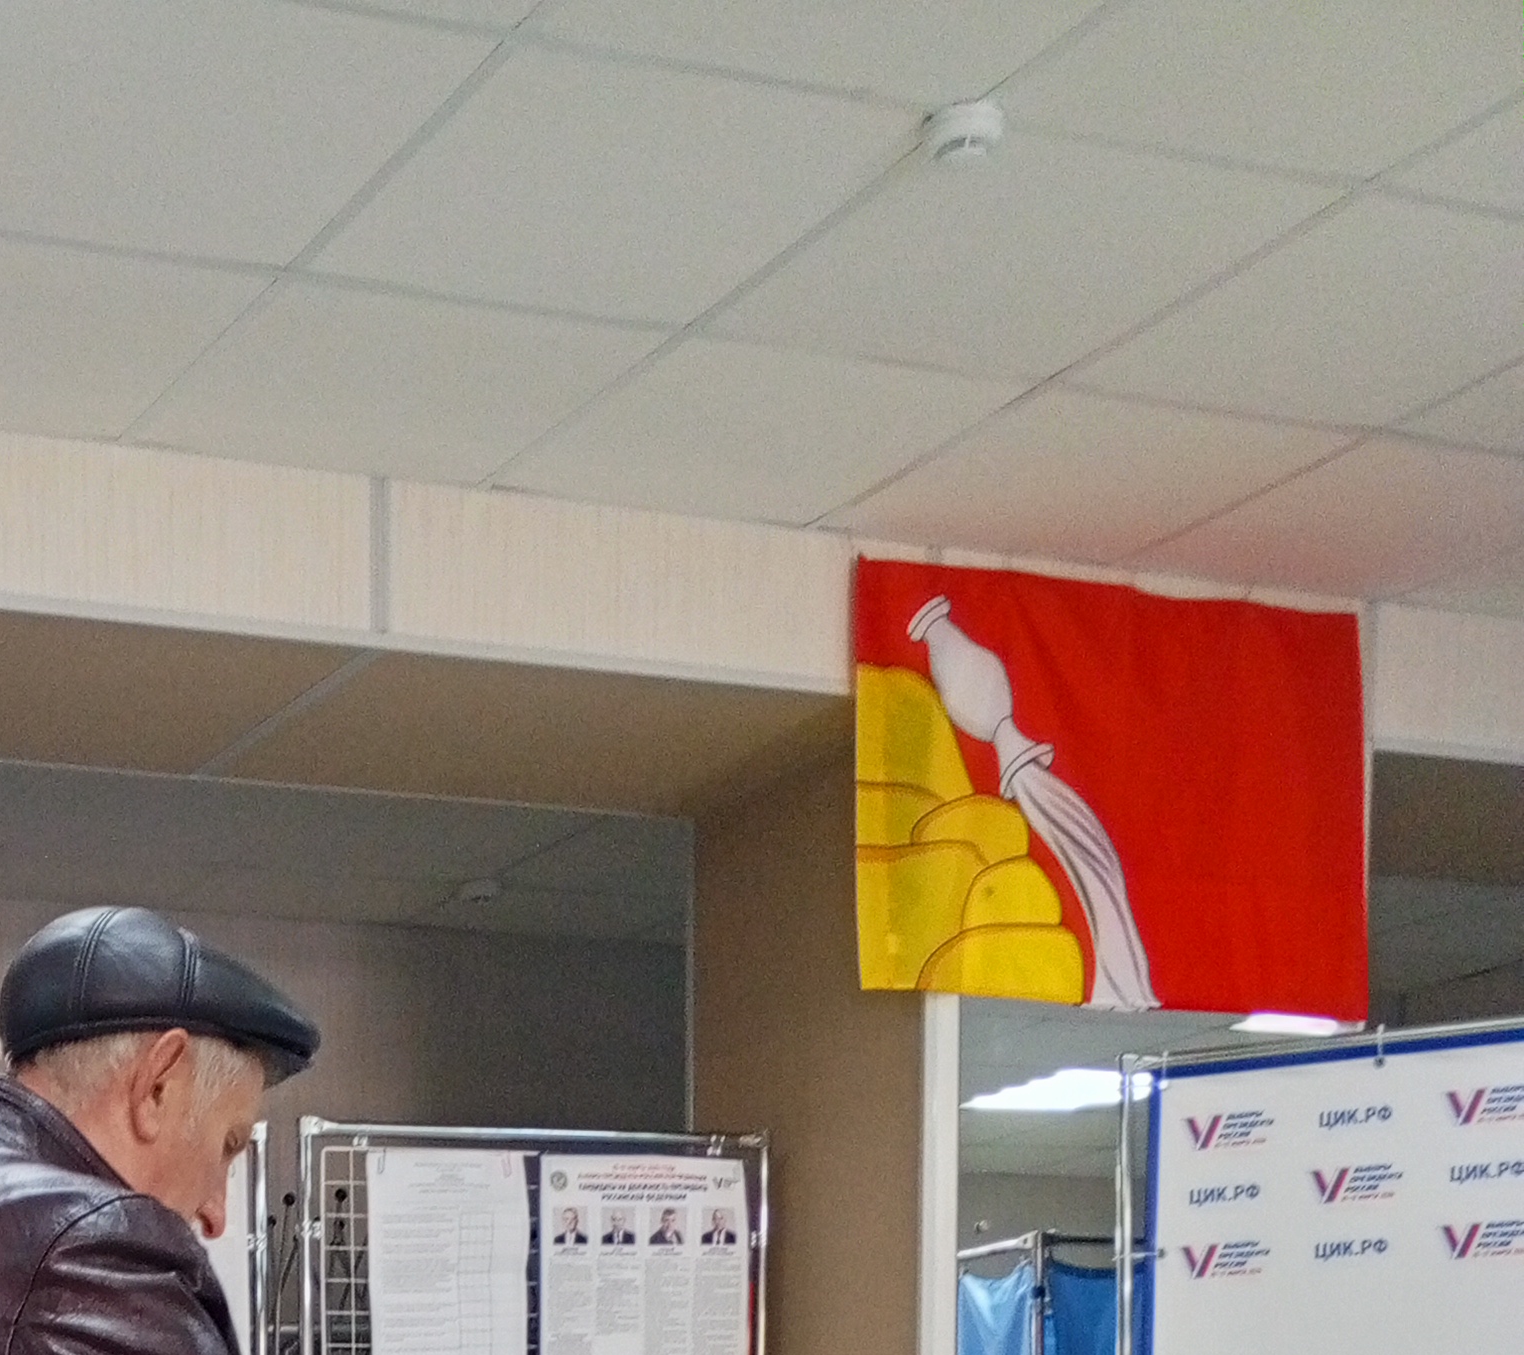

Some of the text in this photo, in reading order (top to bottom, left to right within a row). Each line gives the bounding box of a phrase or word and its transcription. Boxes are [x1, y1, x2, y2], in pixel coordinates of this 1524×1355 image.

[1318, 1104, 1392, 1130] ЦИК.РФ
[1189, 1184, 1260, 1206] ЦИК.РФ
[1314, 1238, 1388, 1262] ЦИК.РФ
